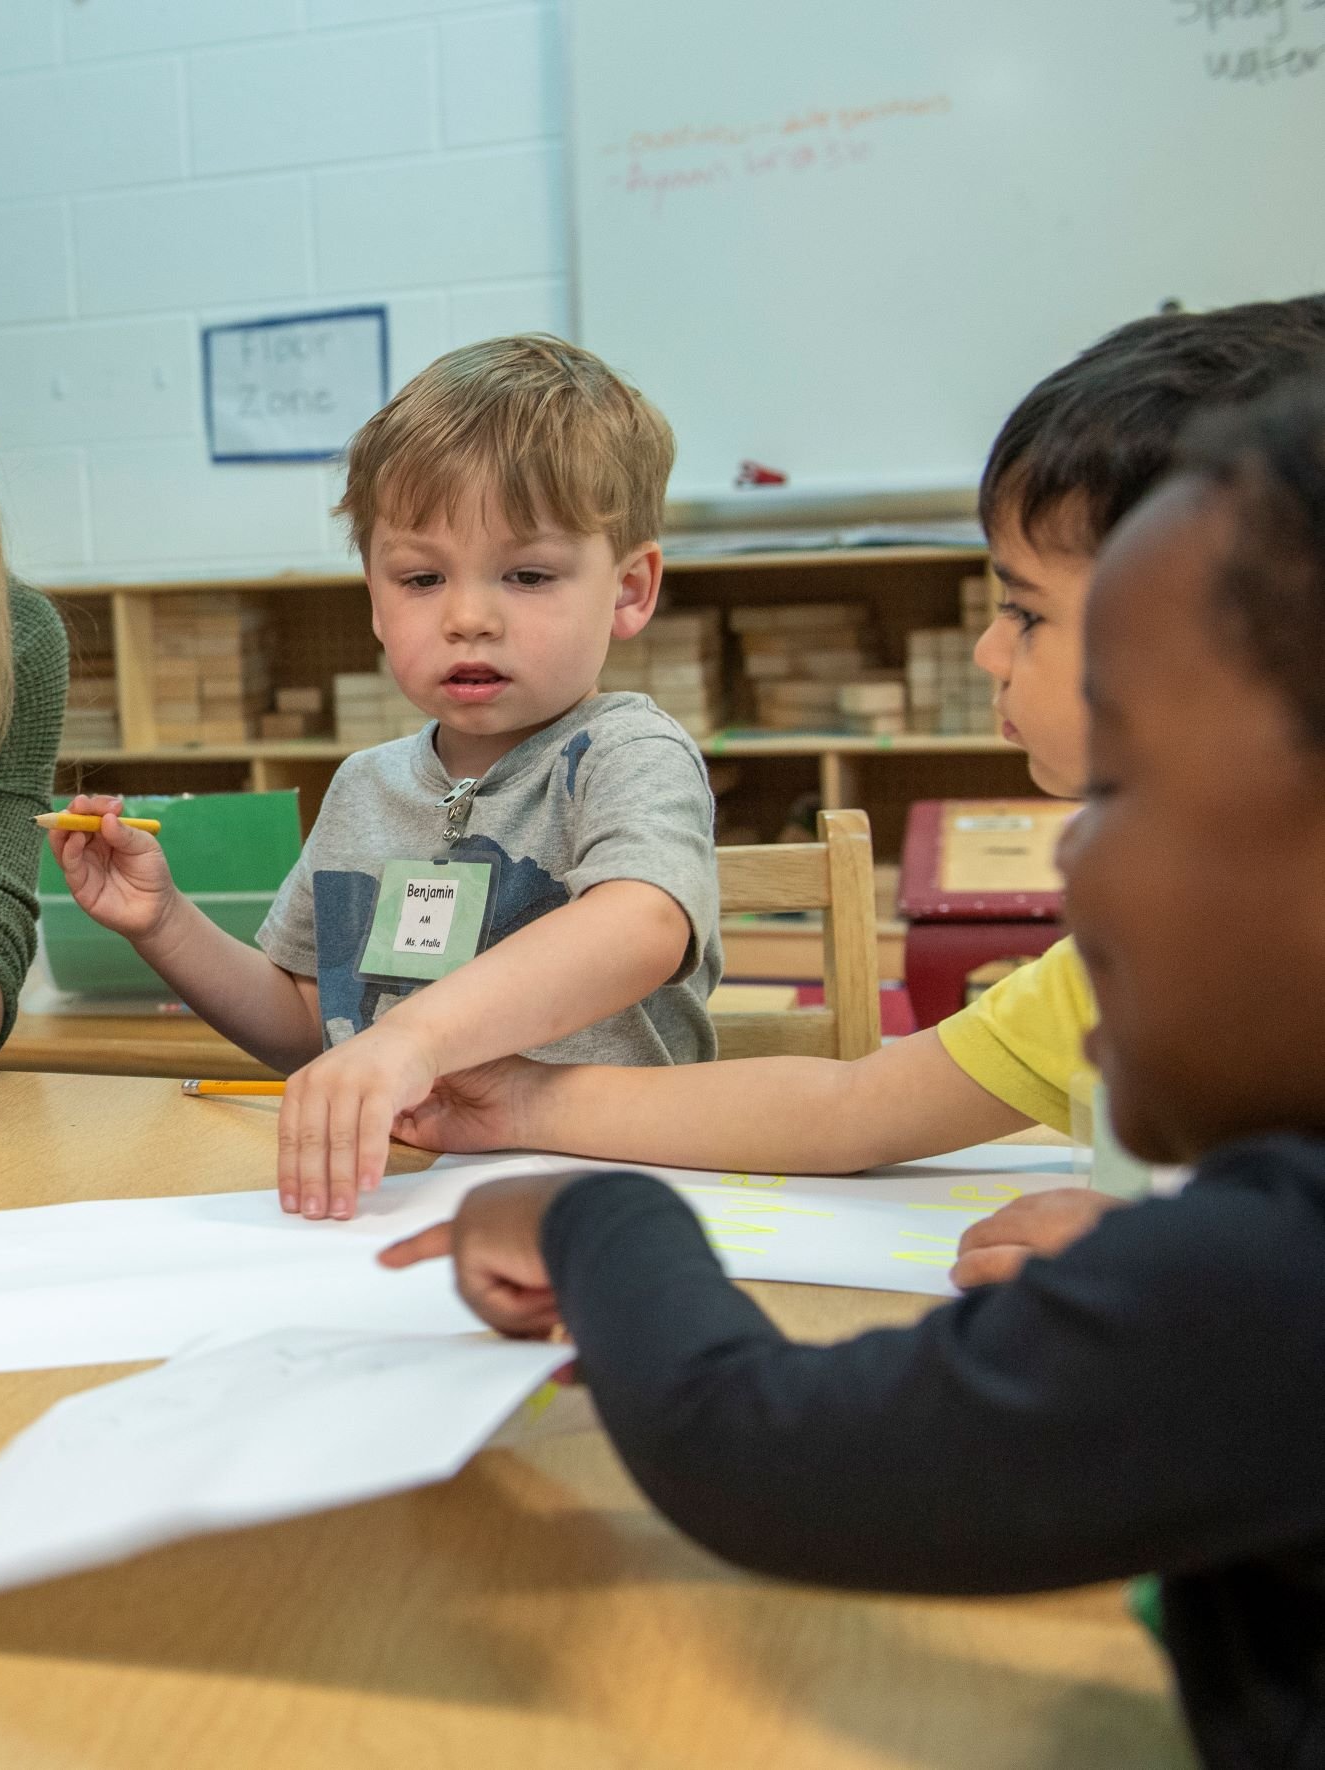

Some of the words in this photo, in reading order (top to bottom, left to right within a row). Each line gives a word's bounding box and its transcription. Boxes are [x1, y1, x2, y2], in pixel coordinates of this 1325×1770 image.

[238, 383, 336, 419] Zone
[407, 884, 454, 902] Benjamin
[419, 915, 431, 925] AM
[405, 937, 417, 947] Ms.
[420, 939, 441, 948] Atalla
[891, 1183, 1022, 1268] Nle
